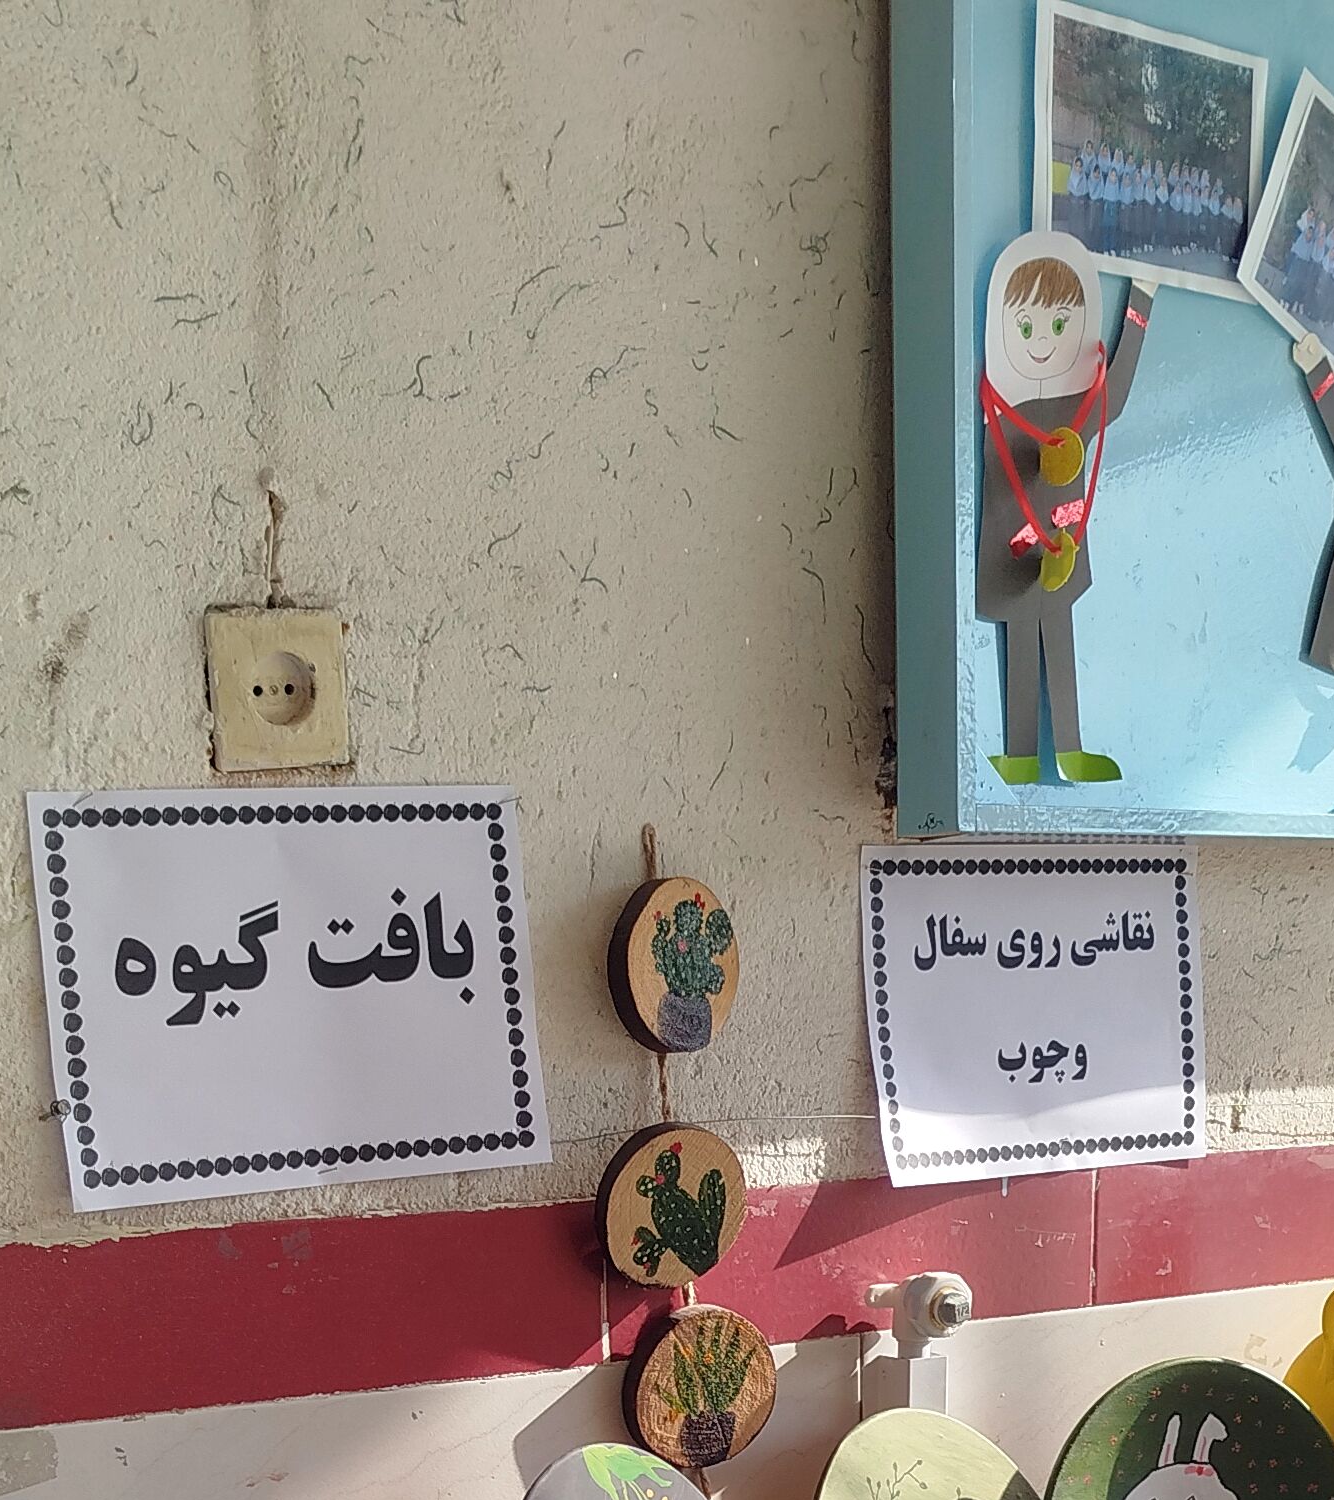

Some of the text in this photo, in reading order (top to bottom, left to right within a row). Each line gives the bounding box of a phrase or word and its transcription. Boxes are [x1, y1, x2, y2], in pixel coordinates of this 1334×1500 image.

[115, 888, 474, 1026] بافت گیوه
[914, 910, 1155, 970] نقاشی روی سفال
